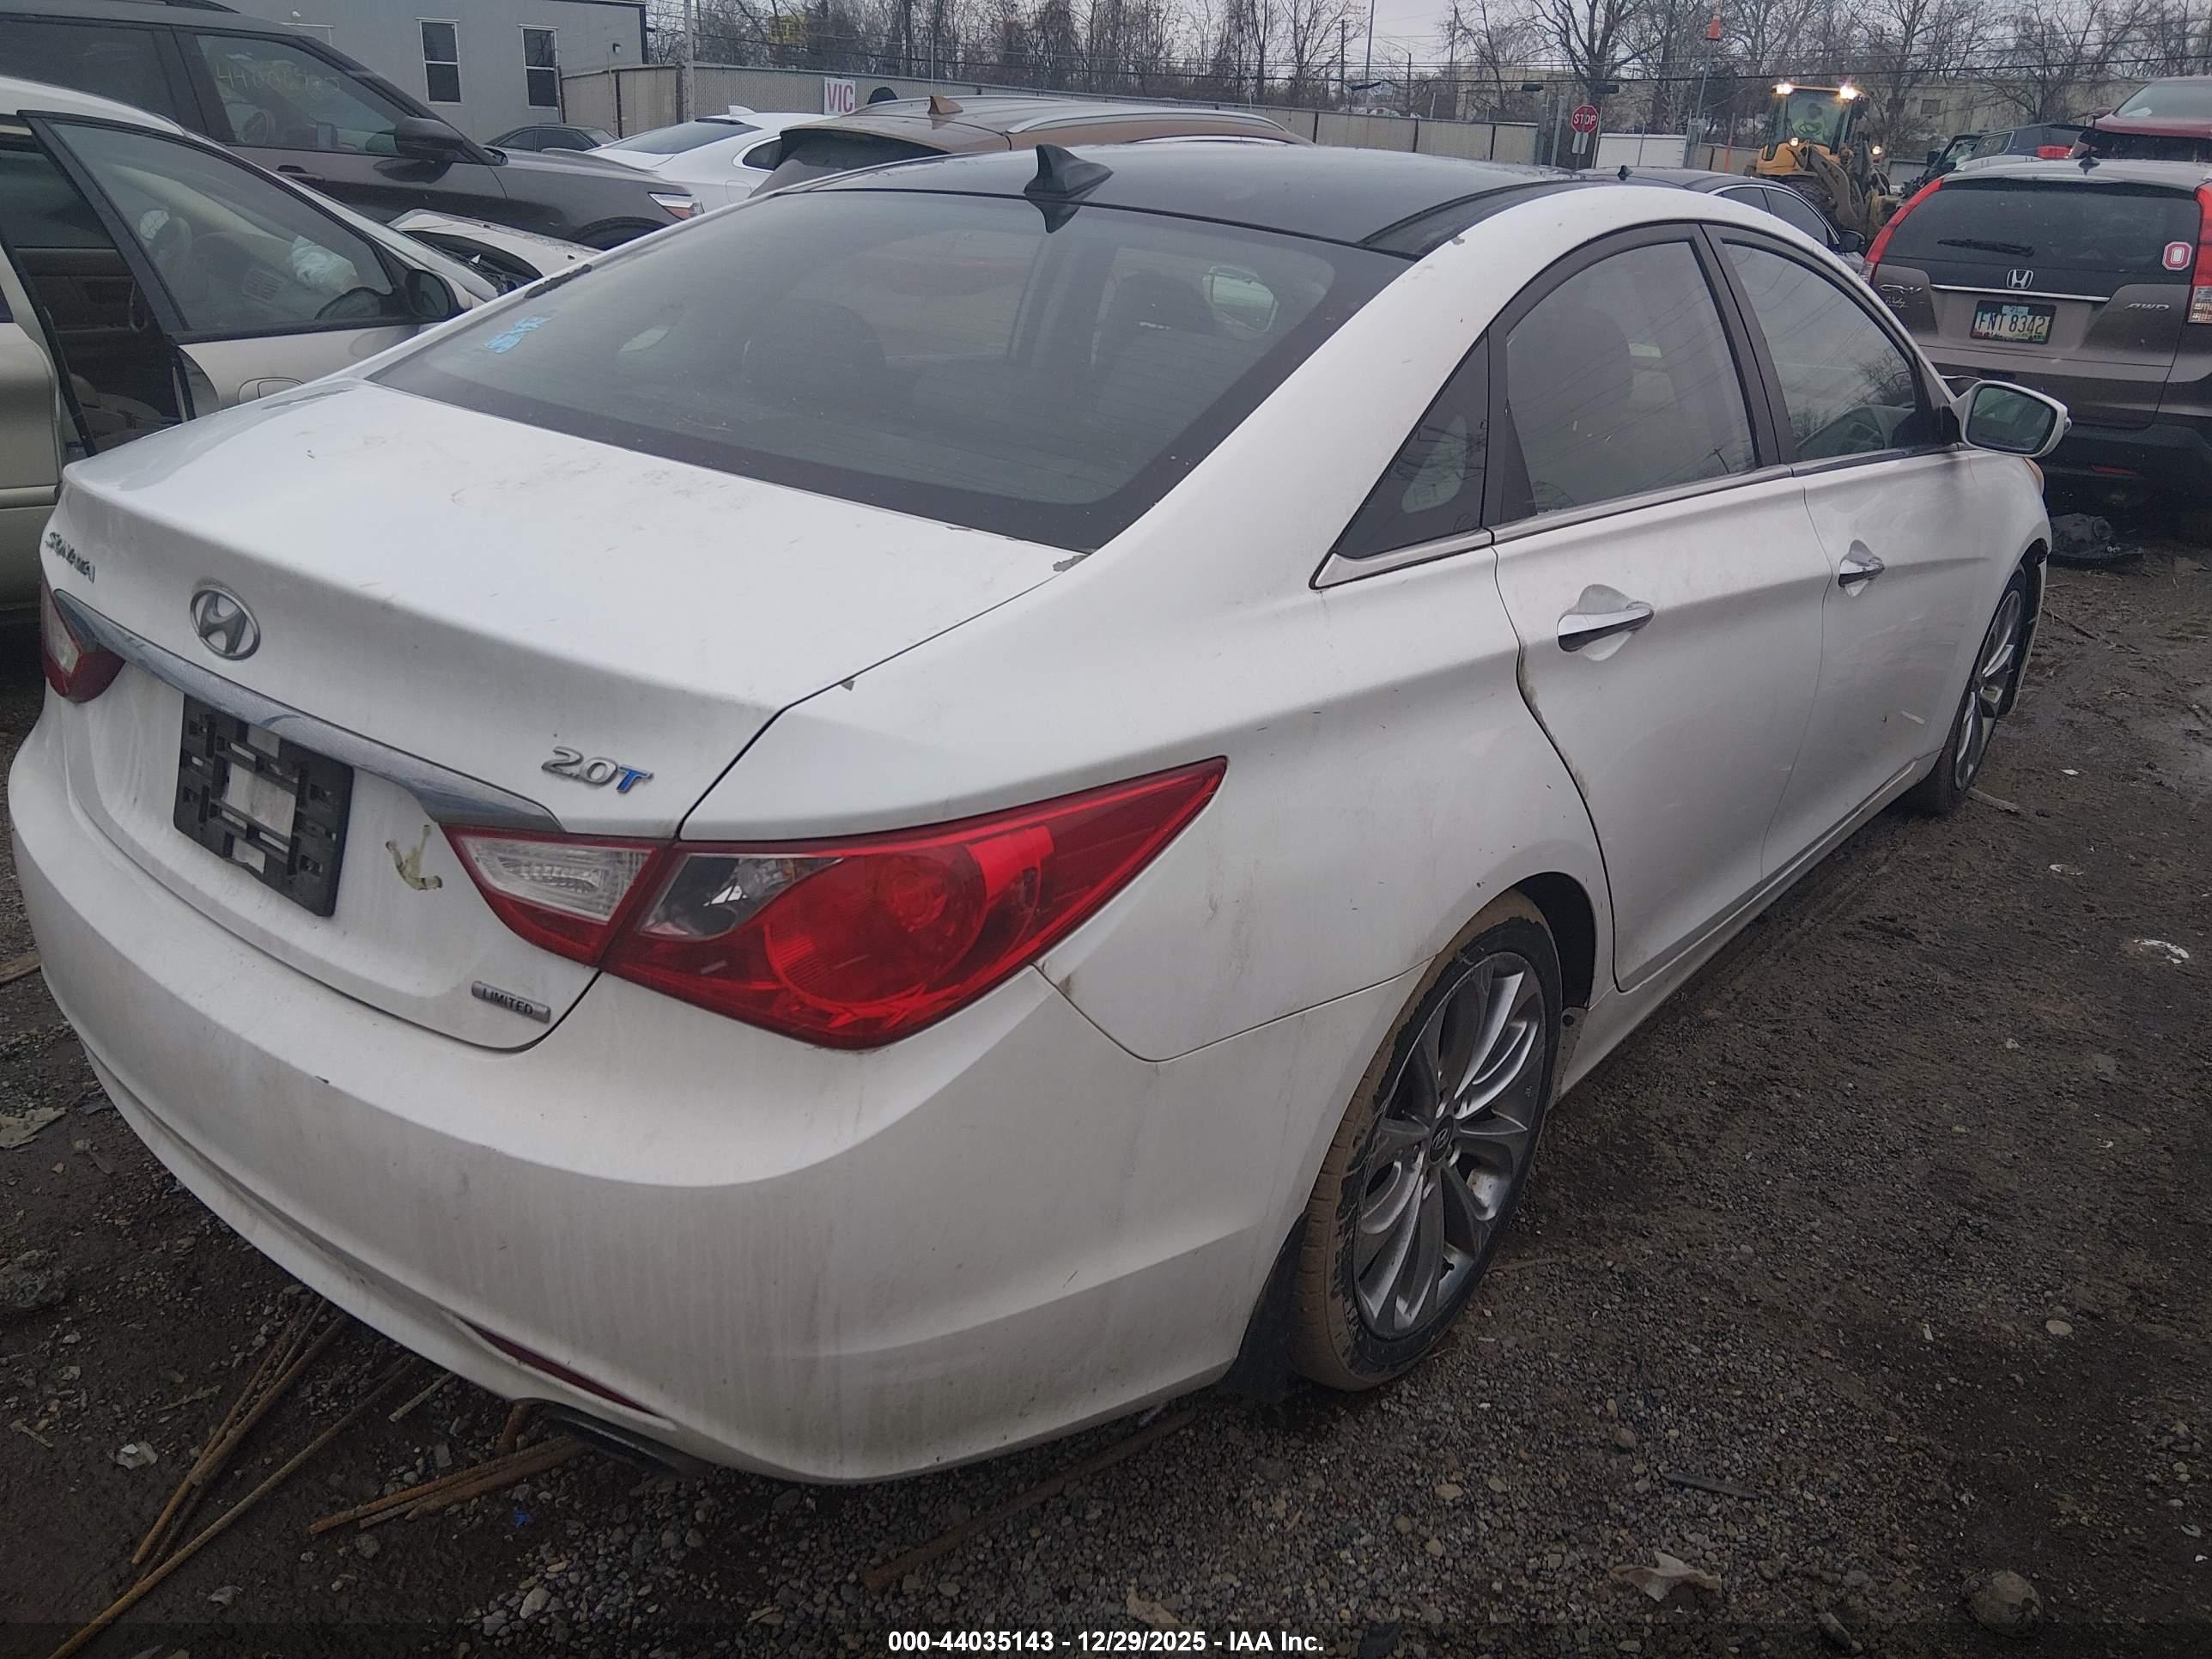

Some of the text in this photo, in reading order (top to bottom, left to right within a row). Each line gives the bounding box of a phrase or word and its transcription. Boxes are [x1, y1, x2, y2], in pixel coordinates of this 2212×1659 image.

[827, 82, 854, 112] VIC
[1573, 113, 1597, 125] STOP
[1978, 312, 2046, 335] FNT 8342
[482, 988, 533, 1015] LIMITED
